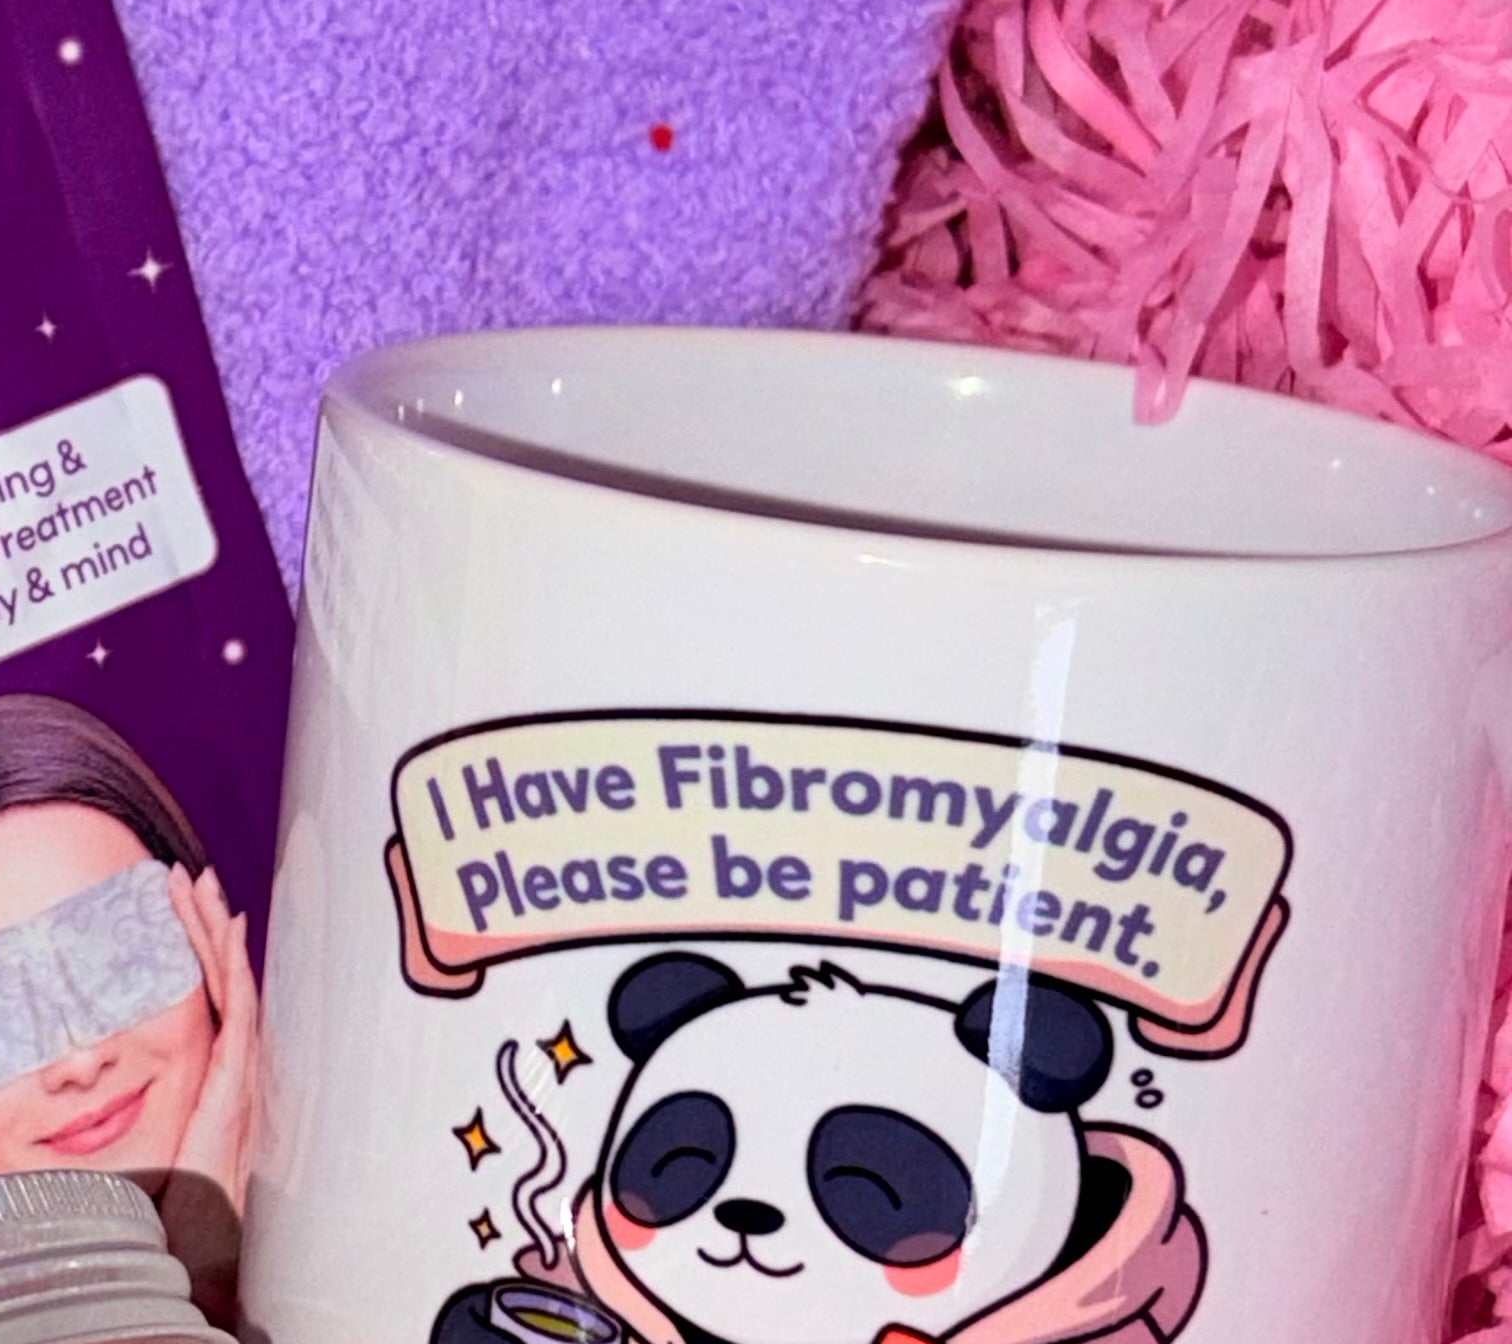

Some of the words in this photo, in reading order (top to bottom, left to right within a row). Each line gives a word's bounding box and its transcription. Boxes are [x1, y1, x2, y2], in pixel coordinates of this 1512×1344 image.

[57, 439, 88, 475] &
[26, 567, 56, 603] &
[60, 523, 153, 590] mind
[427, 777, 454, 842] I
[462, 756, 637, 829] Have
[655, 742, 1230, 915] Fibromyalgia,
[456, 851, 690, 934] Please
[711, 834, 813, 904] be
[835, 857, 1163, 979] patient.
